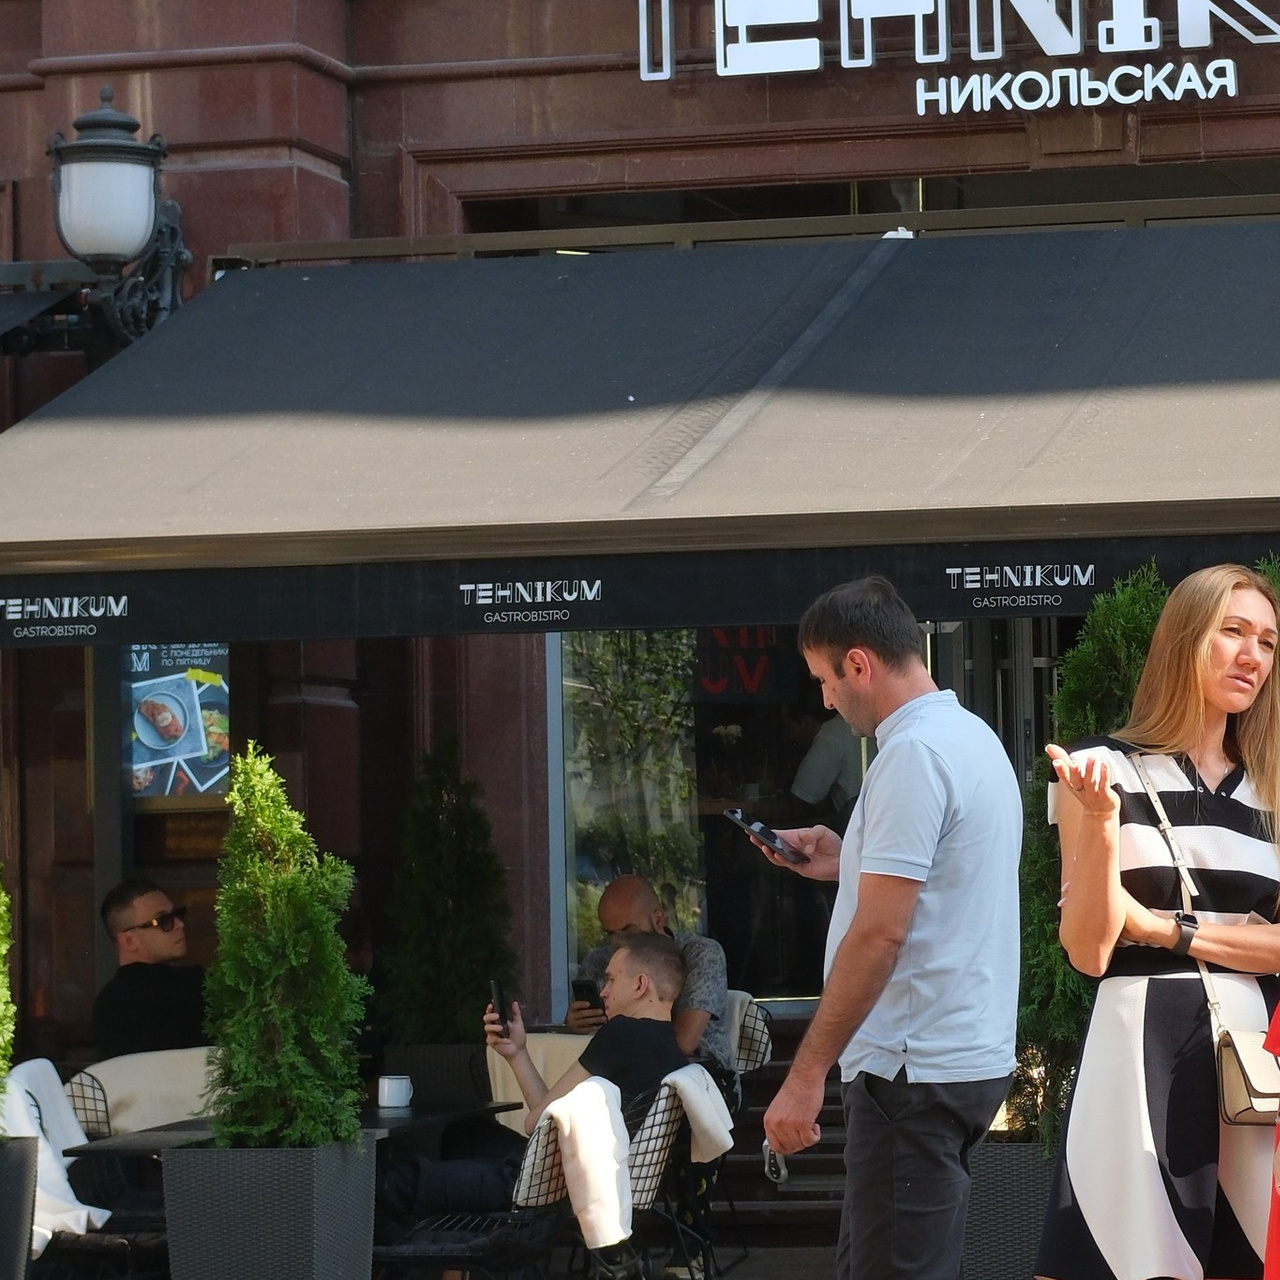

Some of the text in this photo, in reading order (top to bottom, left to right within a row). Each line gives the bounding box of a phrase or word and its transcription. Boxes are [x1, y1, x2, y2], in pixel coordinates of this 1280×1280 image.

[916, 58, 1238, 116] НИКОЛЬСКАЯ
[945, 564, 1095, 589] TEHNIKUM
[459, 579, 602, 605] TEHNIKUM
[972, 594, 1063, 609] GASTROBISTRO
[483, 609, 571, 624] GASTROBISTRO
[13, 624, 98, 639] GASTROBISTRO
